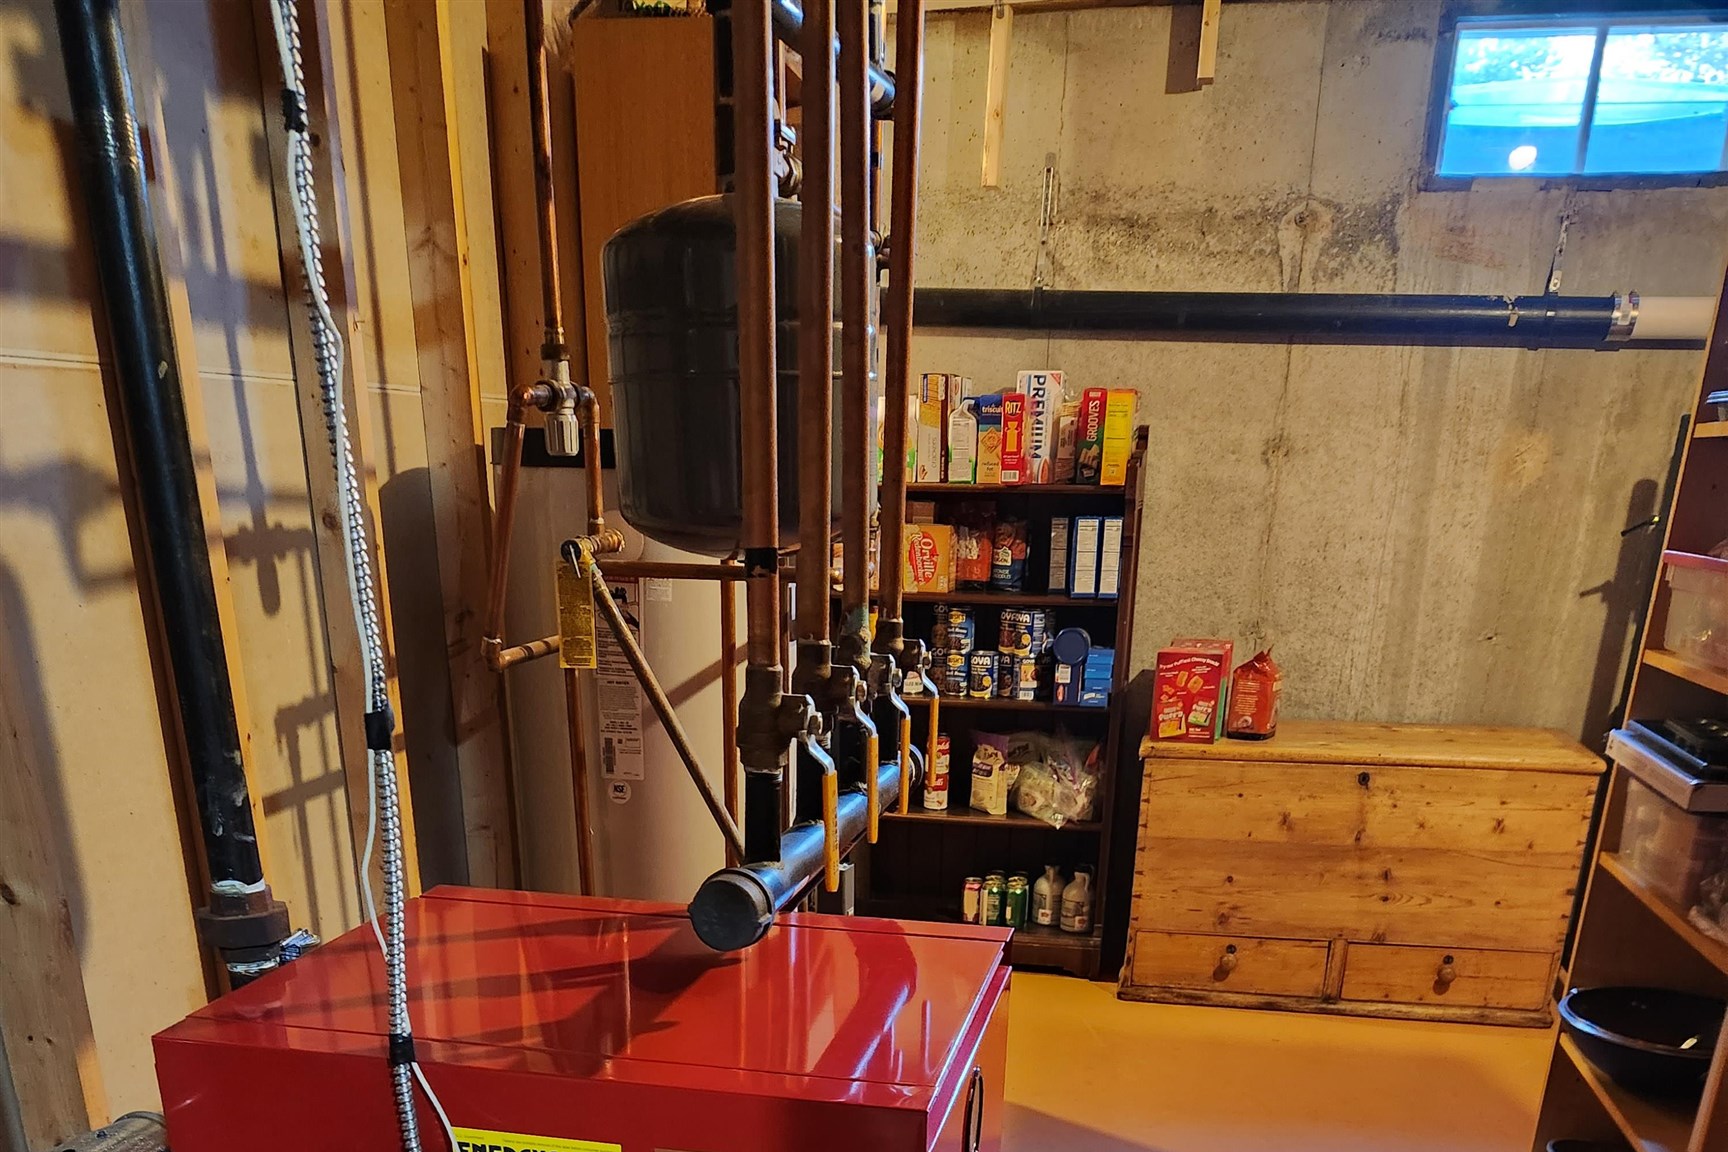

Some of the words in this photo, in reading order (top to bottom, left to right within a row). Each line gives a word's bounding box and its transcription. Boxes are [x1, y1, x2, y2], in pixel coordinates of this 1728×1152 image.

[1005, 401, 1022, 414] RITZ
[1029, 375, 1047, 459] PREMIUM
[1086, 400, 1101, 442] GROOVES
[920, 538, 935, 579] Orville
